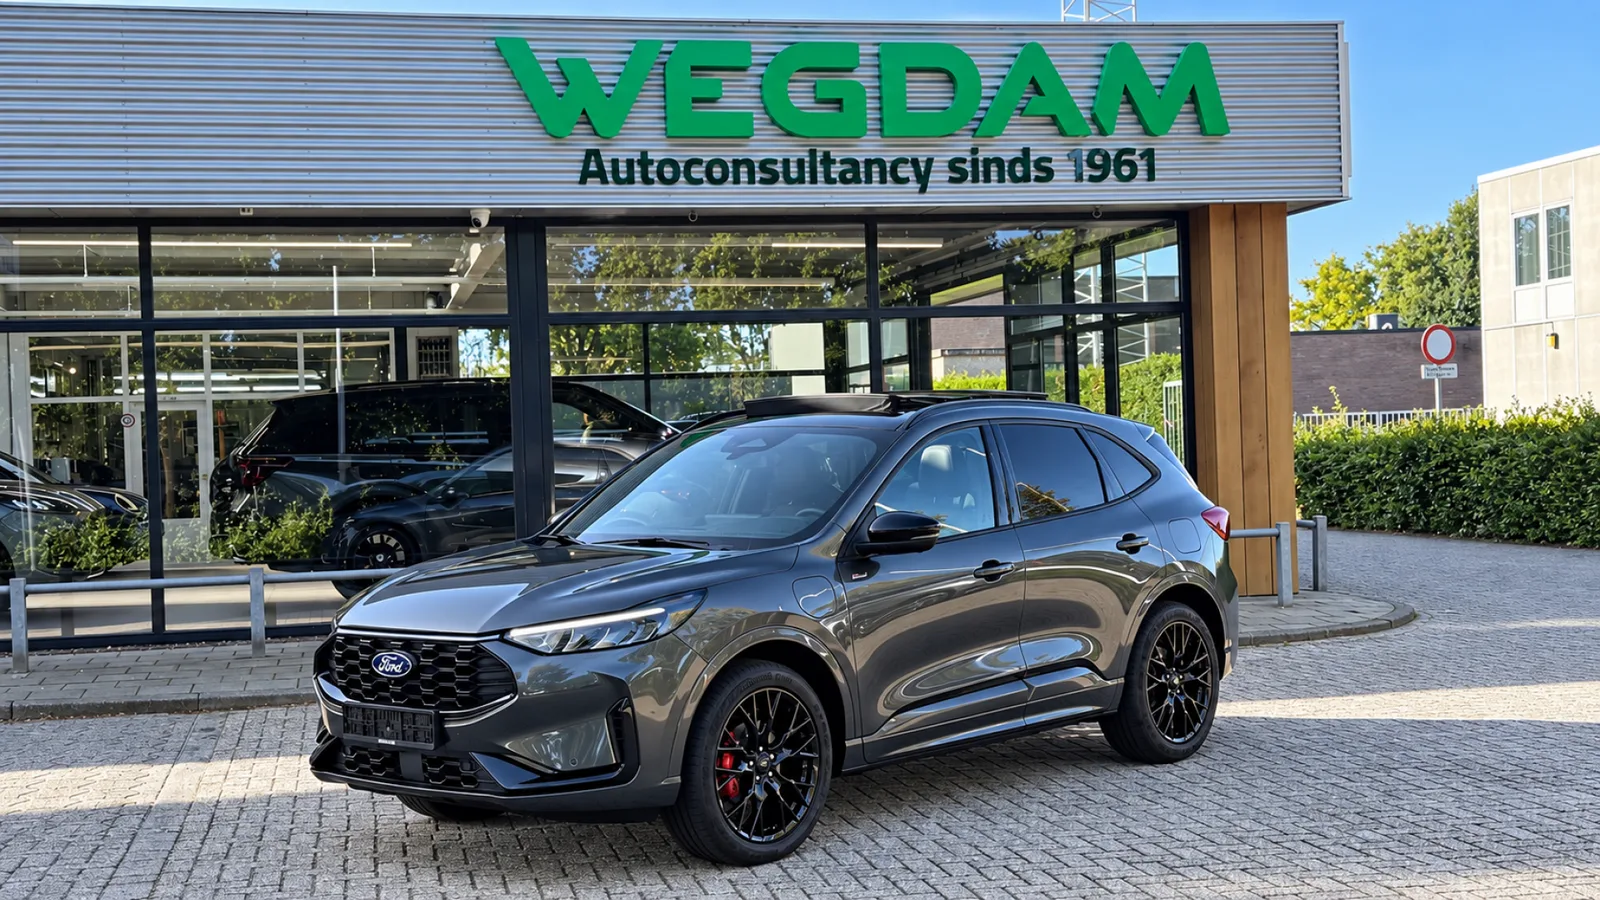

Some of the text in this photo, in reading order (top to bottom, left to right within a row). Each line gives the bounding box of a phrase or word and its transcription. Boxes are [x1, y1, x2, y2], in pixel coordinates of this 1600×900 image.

[495, 37, 1231, 138] WEGDAM
[579, 147, 1156, 193] Autoconsultancy sinds 1961
[378, 655, 404, 673] Ford
